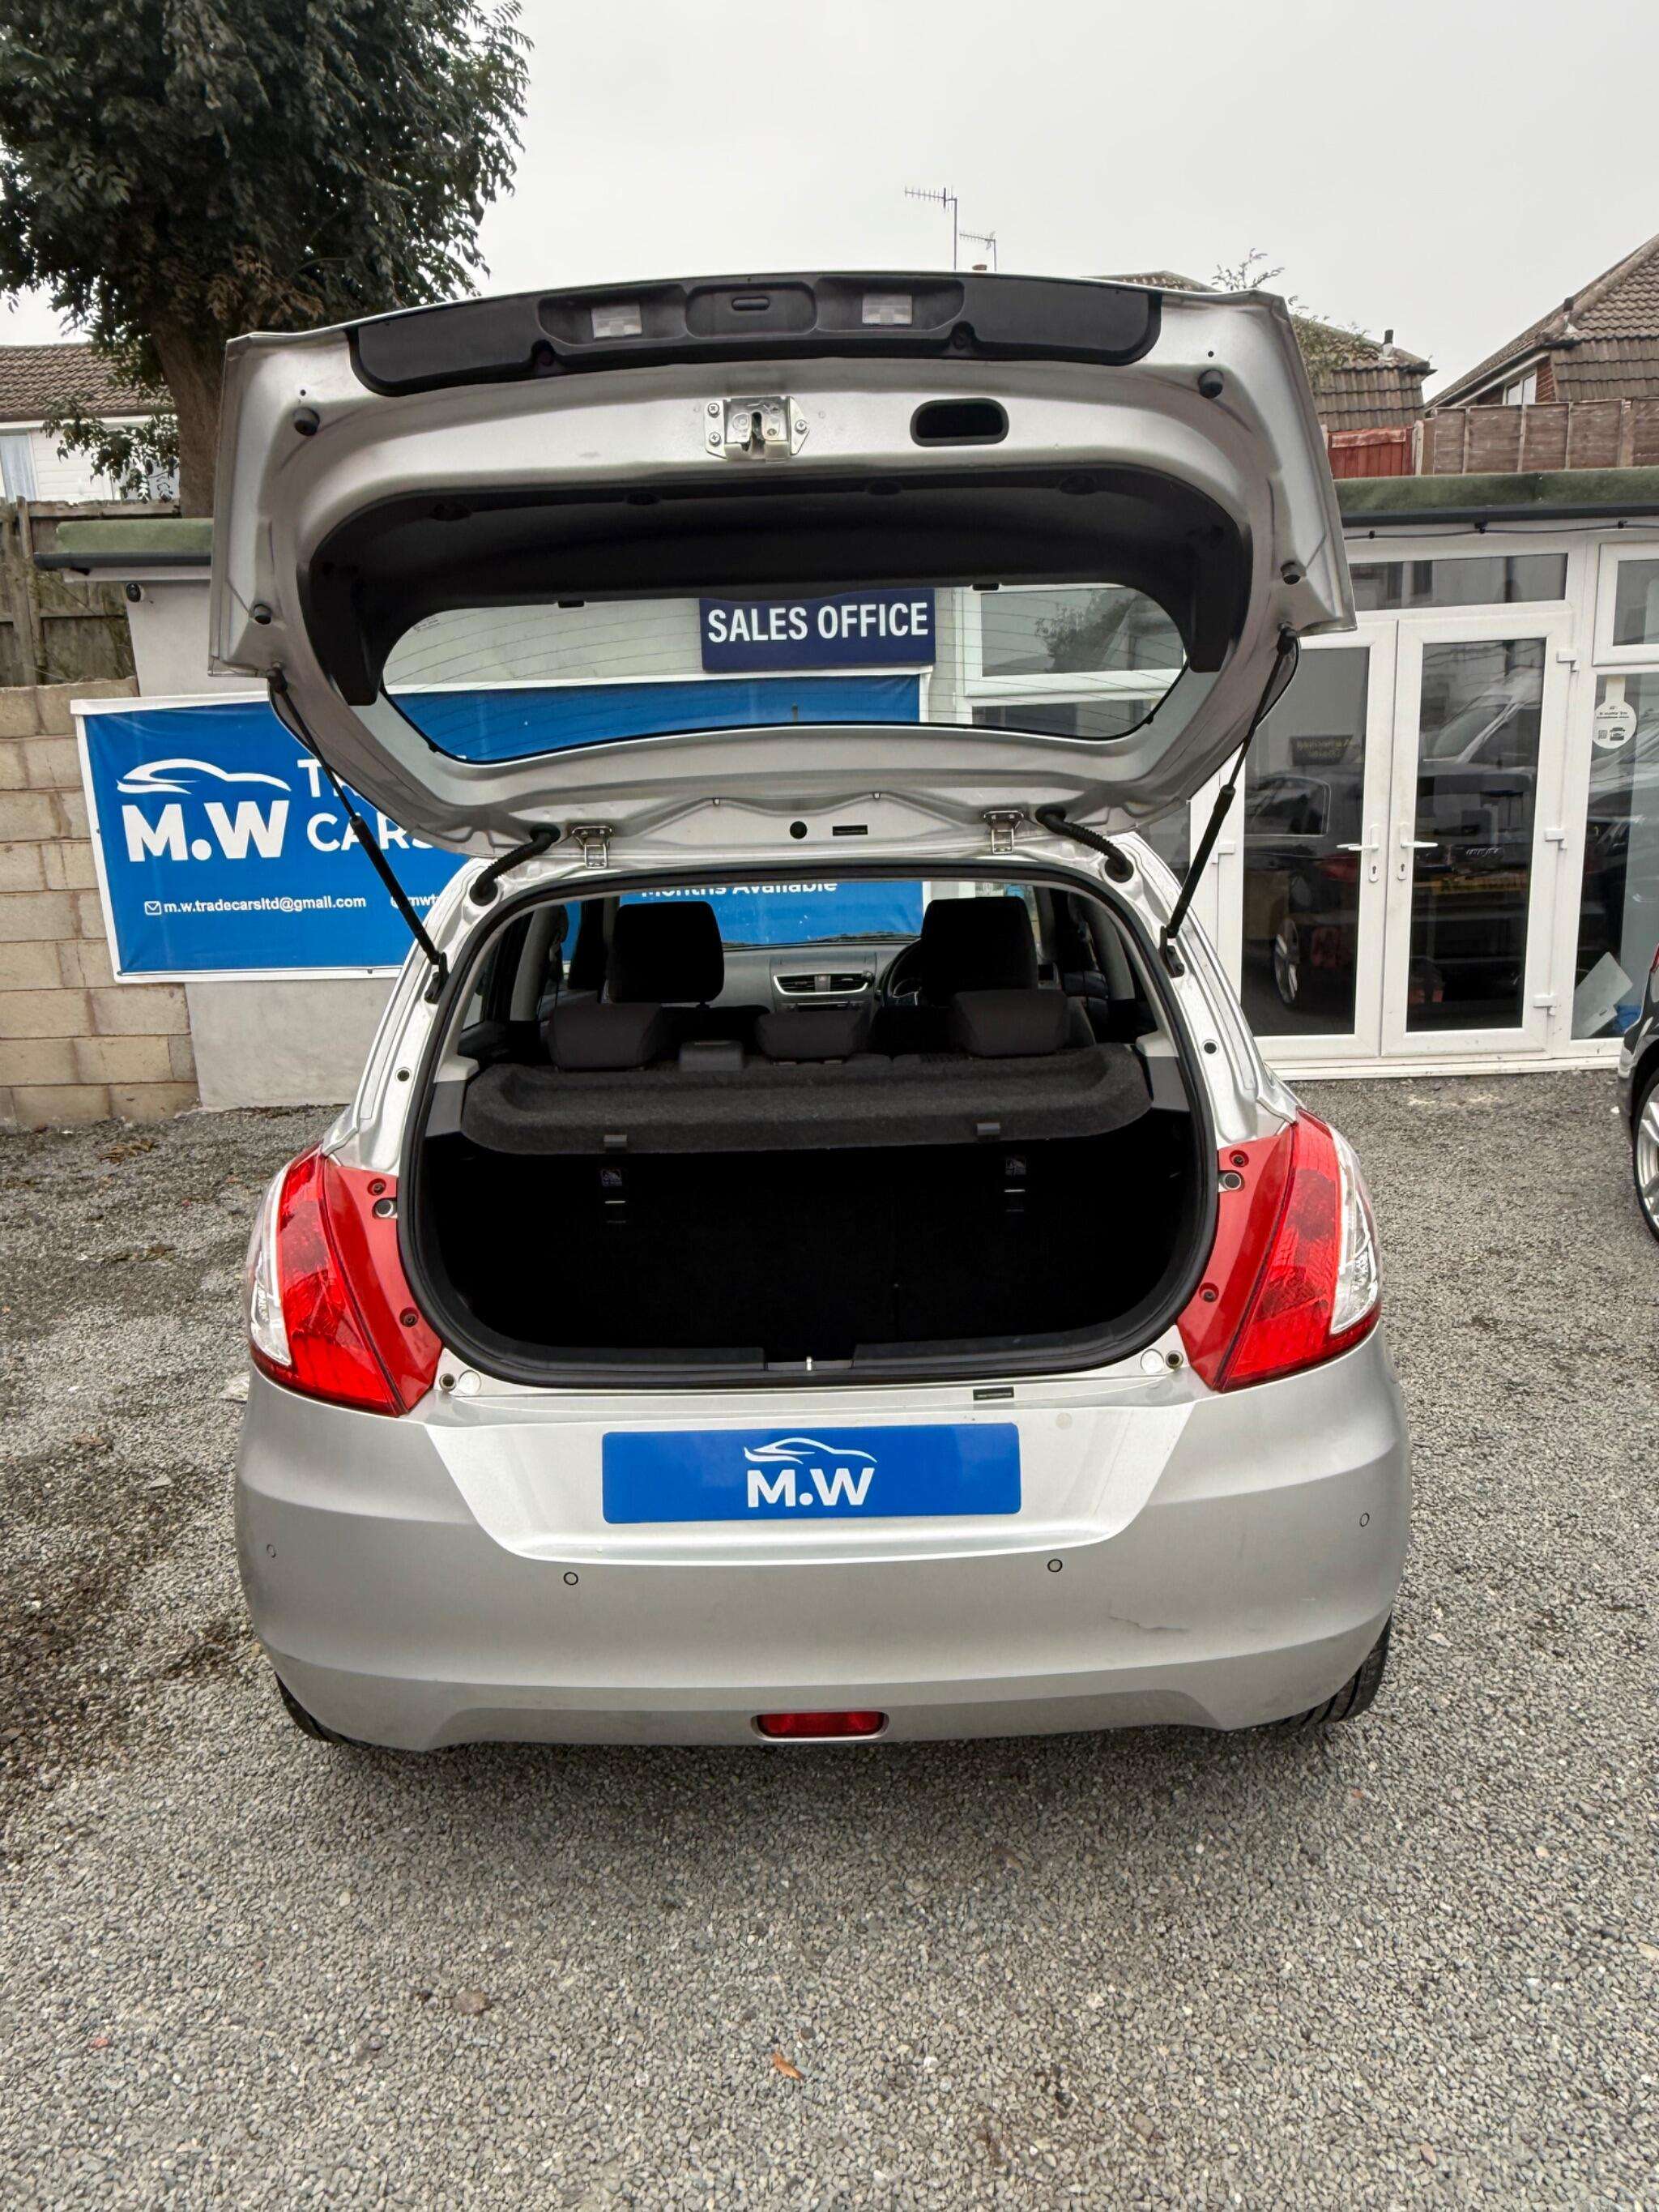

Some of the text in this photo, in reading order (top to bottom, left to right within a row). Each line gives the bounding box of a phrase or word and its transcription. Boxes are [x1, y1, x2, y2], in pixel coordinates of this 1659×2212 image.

[707, 602, 928, 643] SALES OFFICE
[122, 800, 290, 863] M.W
[307, 812, 433, 852] CAR
[747, 1467, 875, 1508] M.W
